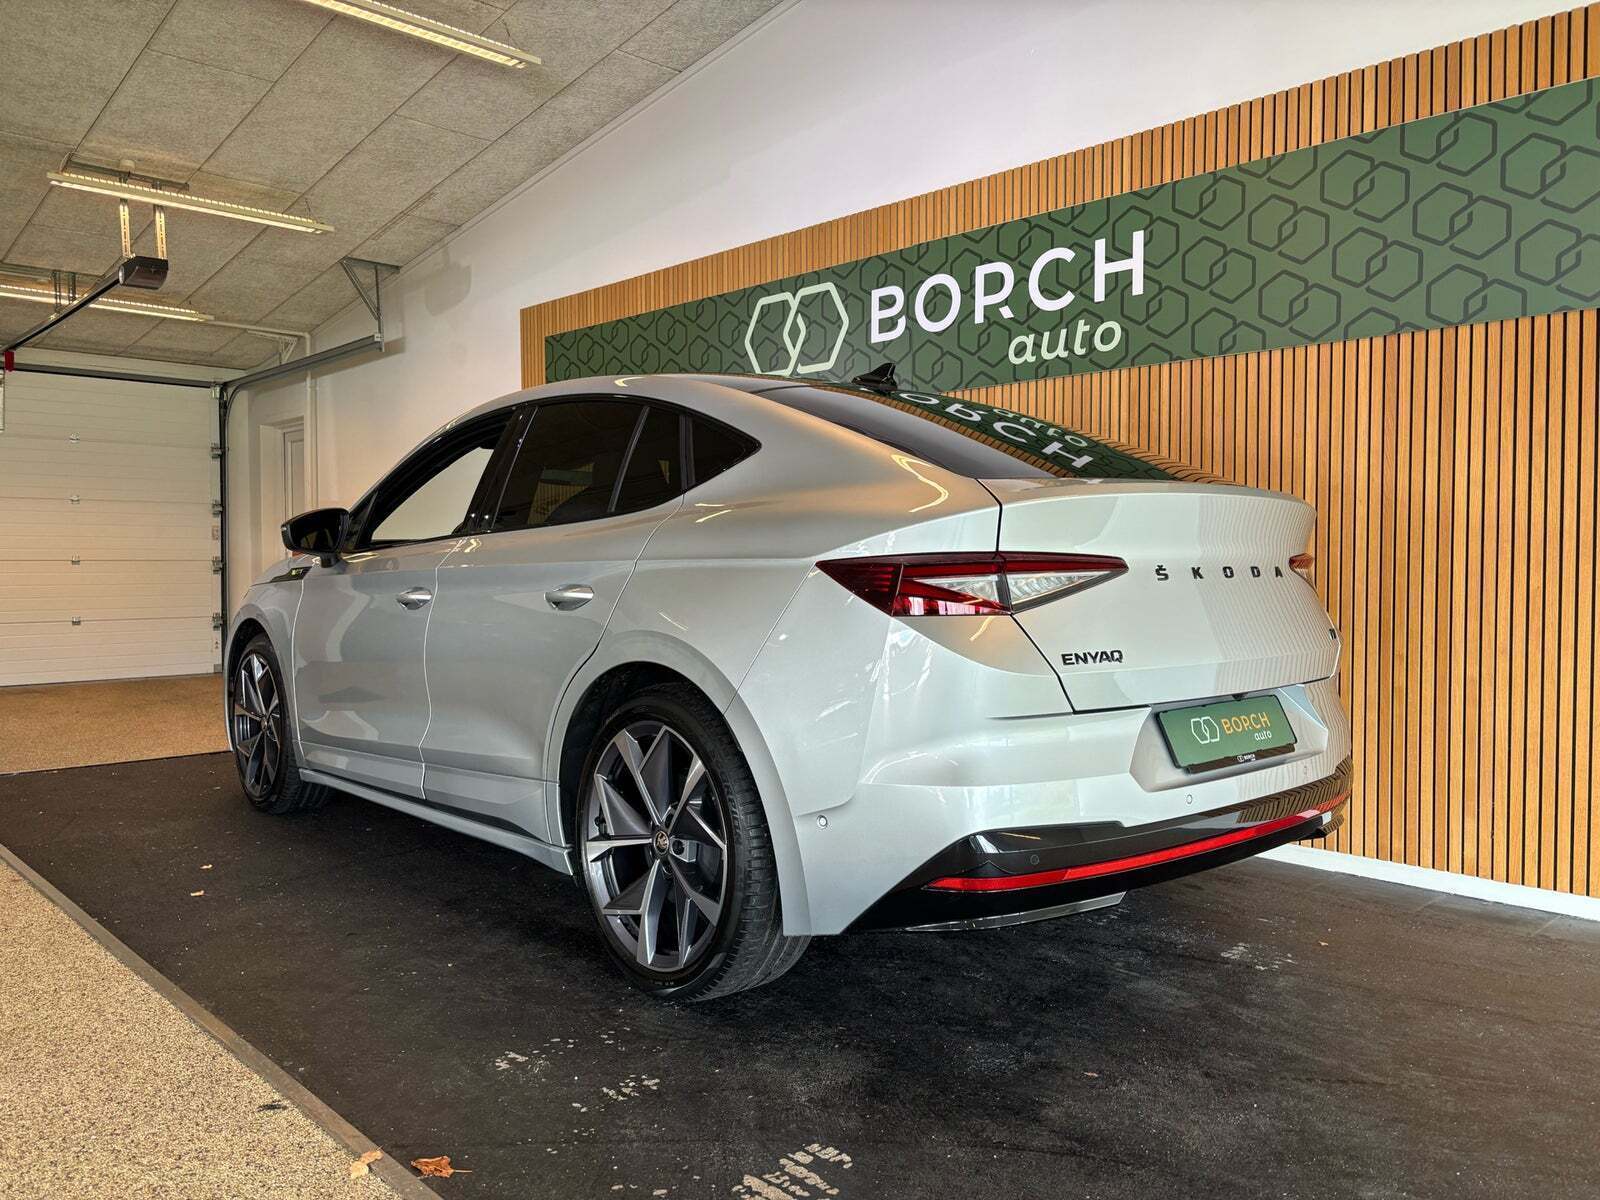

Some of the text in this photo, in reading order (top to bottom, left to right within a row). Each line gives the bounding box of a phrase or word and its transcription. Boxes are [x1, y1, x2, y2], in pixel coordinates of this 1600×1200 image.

[870, 230, 1145, 344] BORCH
[1008, 320, 1122, 364] auto
[1155, 564, 1284, 581] ŠKODA
[1061, 650, 1124, 666] ENYAQ
[1221, 711, 1271, 735] BORCH
[1254, 730, 1273, 741] auto
